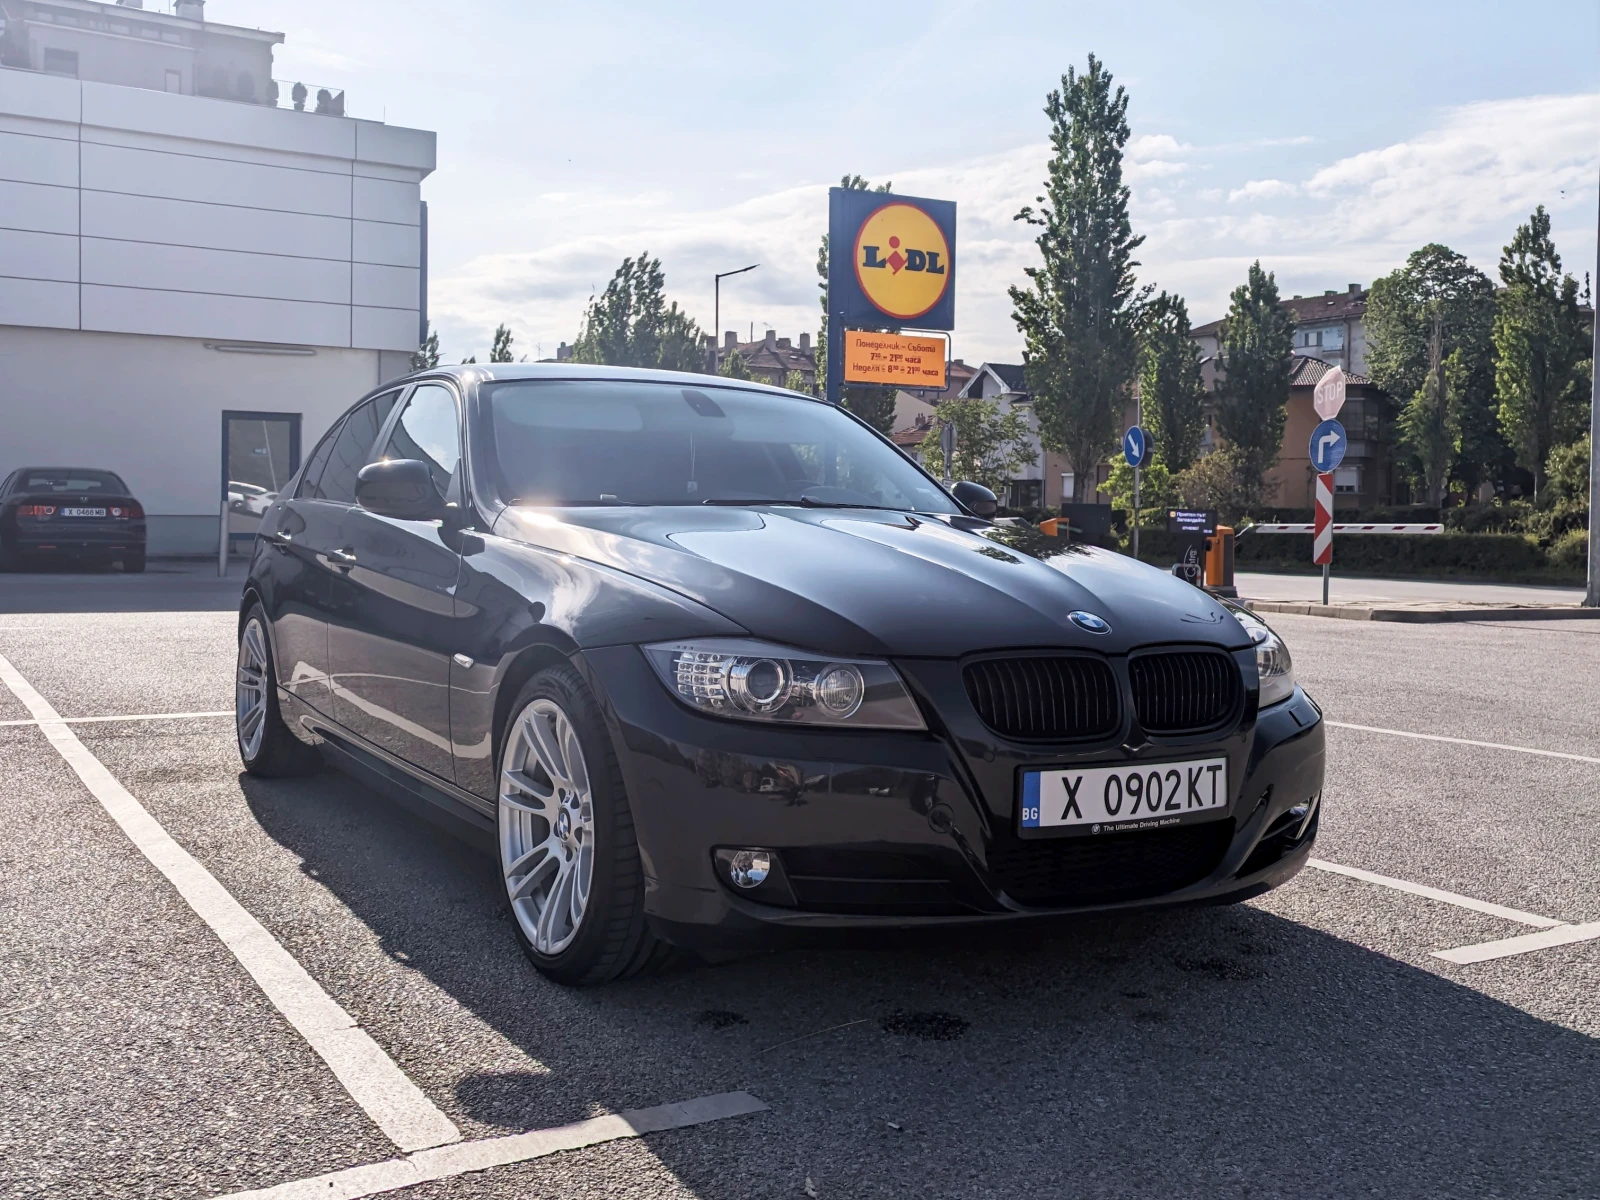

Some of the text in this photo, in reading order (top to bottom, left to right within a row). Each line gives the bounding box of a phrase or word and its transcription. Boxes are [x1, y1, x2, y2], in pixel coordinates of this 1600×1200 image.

[907, 343, 936, 353] Събота
[853, 363, 880, 374] Неделя
[1317, 381, 1343, 405] STOP
[1061, 776, 1083, 820] X
[1022, 807, 1039, 821] BG
[1115, 823, 1139, 831] Ultimate
[1139, 820, 1159, 828] Driving
